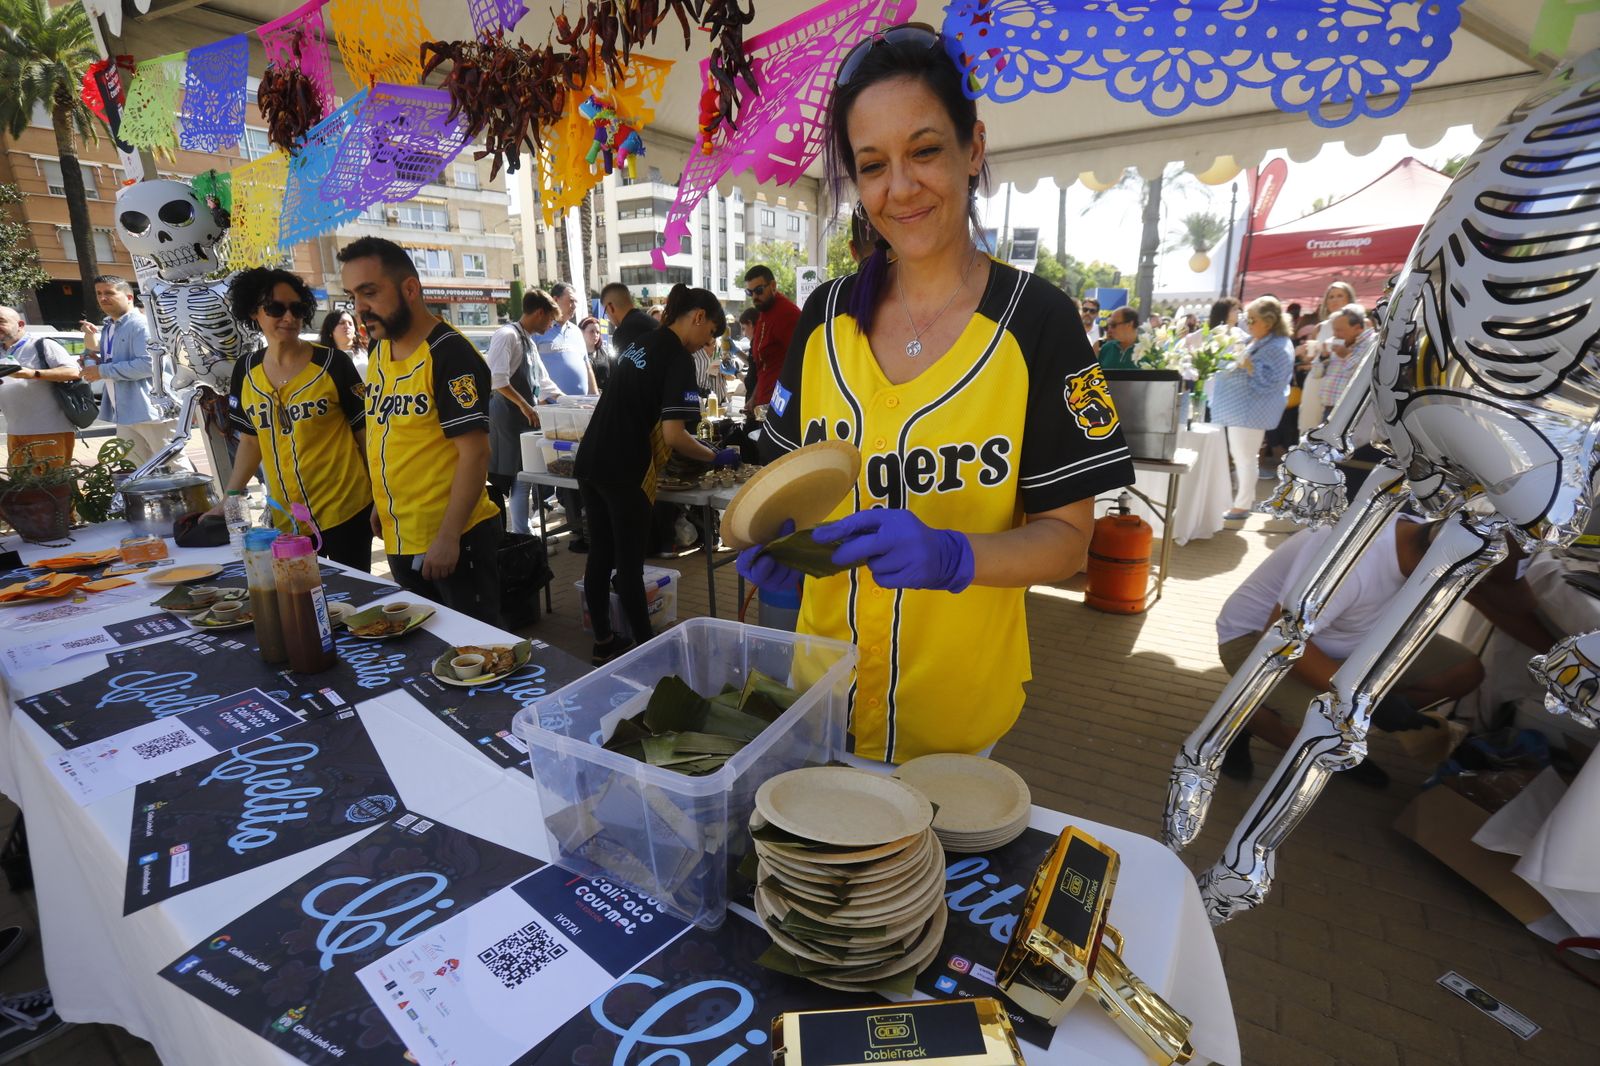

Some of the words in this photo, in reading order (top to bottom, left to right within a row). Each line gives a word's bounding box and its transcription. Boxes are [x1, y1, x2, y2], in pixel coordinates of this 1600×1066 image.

[1305, 237, 1372, 249] Cruzcampo
[1083, 880, 1099, 913] DobleTrack
[554, 913, 582, 936] ¡VOTA!
[310, 1034, 330, 1049] Lindo
[863, 1046, 927, 1061] DobleTrack
